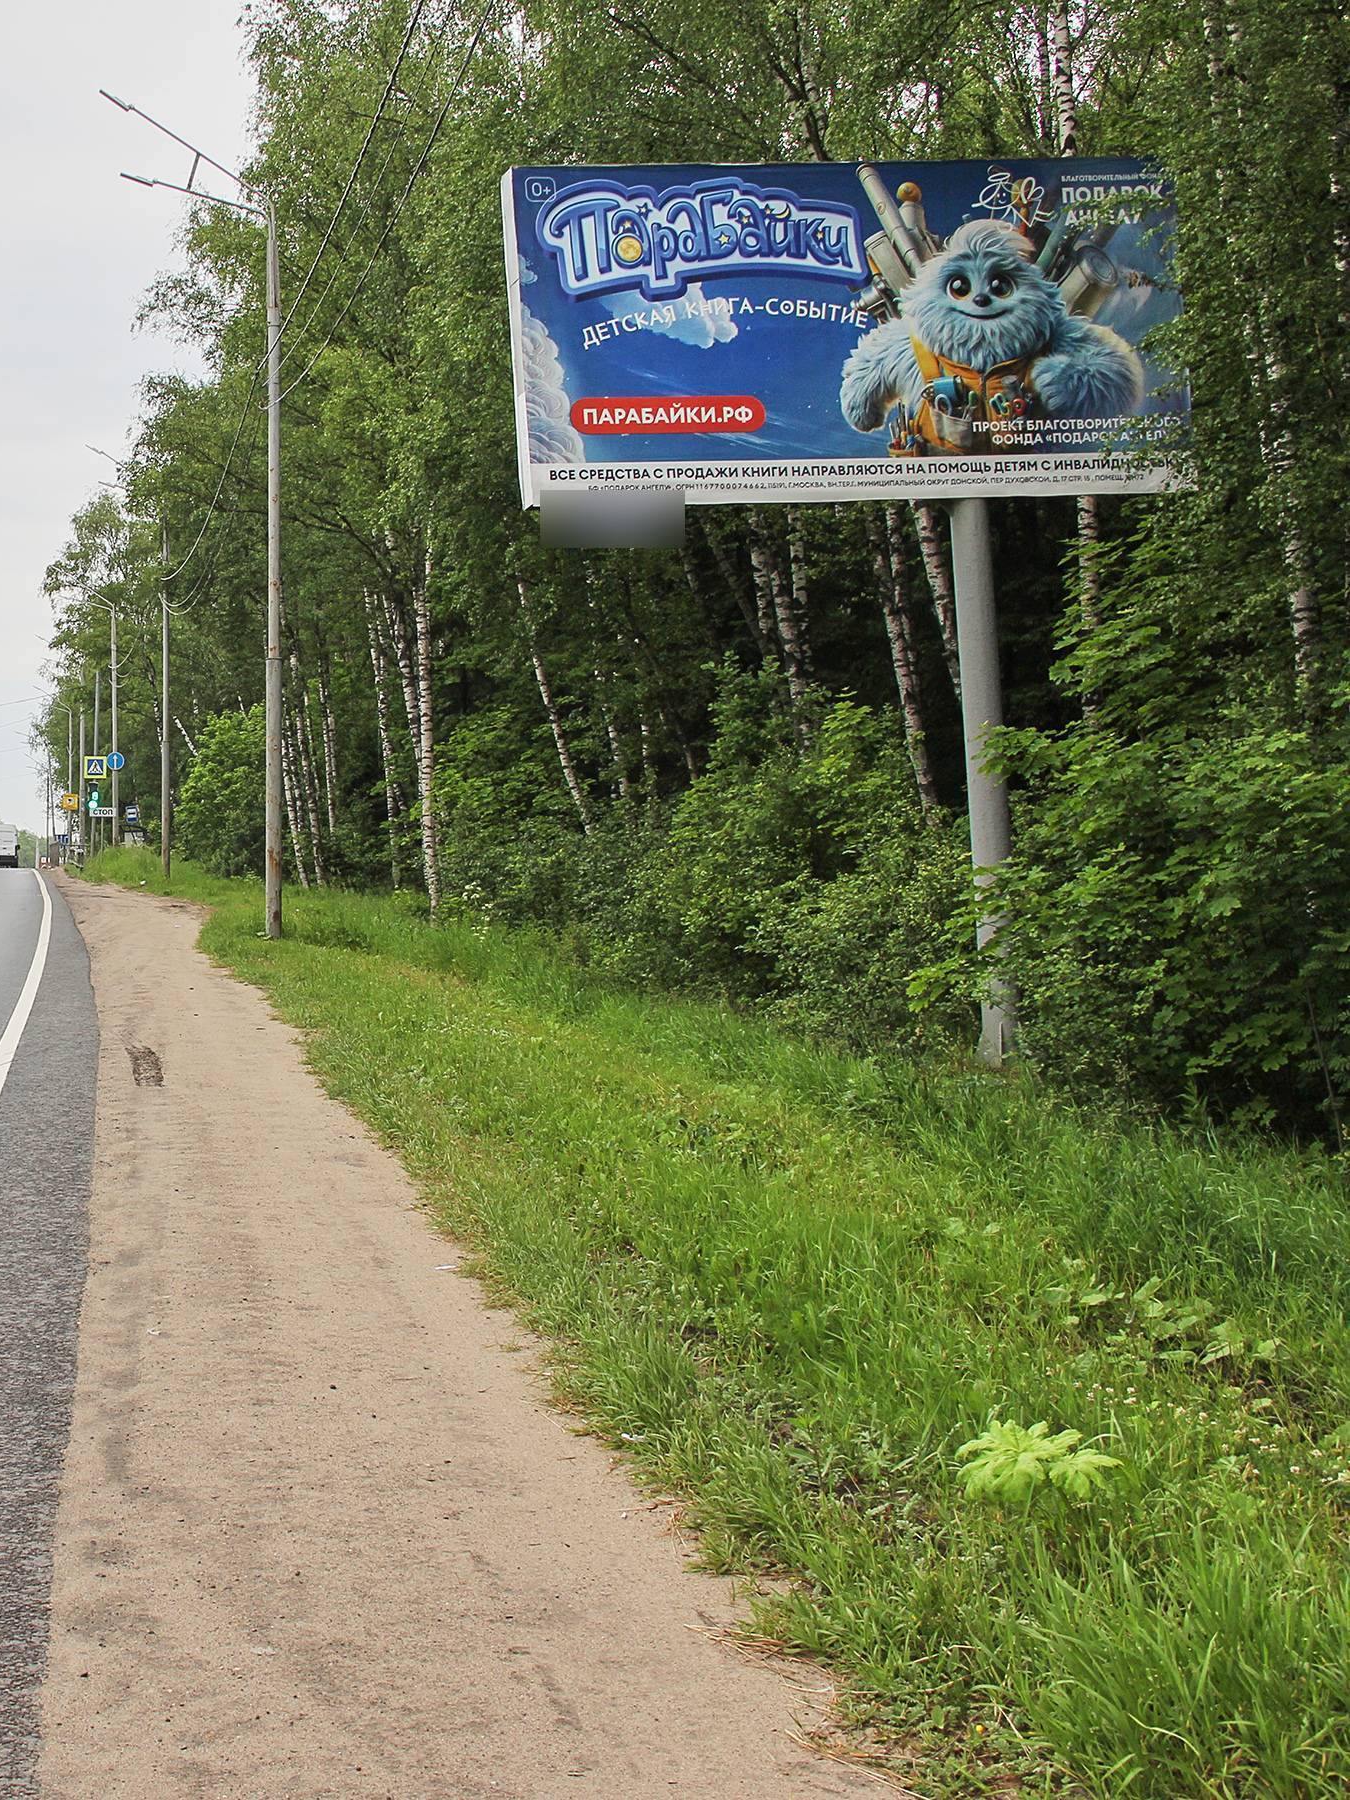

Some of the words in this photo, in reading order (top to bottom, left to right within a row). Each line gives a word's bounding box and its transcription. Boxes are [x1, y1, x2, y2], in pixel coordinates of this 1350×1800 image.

[531, 183, 552, 197] 0+
[582, 305, 676, 350] ДЕТСКАЯ
[685, 297, 870, 329] КНИГА-СОБЫТИЕ
[583, 402, 753, 426] ПАРАБАЙКИ.РФ
[972, 420, 1024, 433] ПРОЕКТ
[992, 433, 1044, 446] ФОНДА
[550, 469, 576, 481] ВСЕ
[578, 468, 651, 482] СРЕДСТВА
[653, 468, 663, 479] С
[667, 467, 738, 480] ПРОДАЖИ
[741, 466, 788, 478] КНИГИ
[791, 463, 903, 477] НАПРАВЛЯЮТСЯ
[906, 463, 926, 474] НА
[928, 461, 991, 475] ПОМОЩЬ
[994, 460, 1038, 474] ДЕТЯМ
[1041, 460, 1052, 471] С
[926, 478, 949, 486] ОКРУГ
